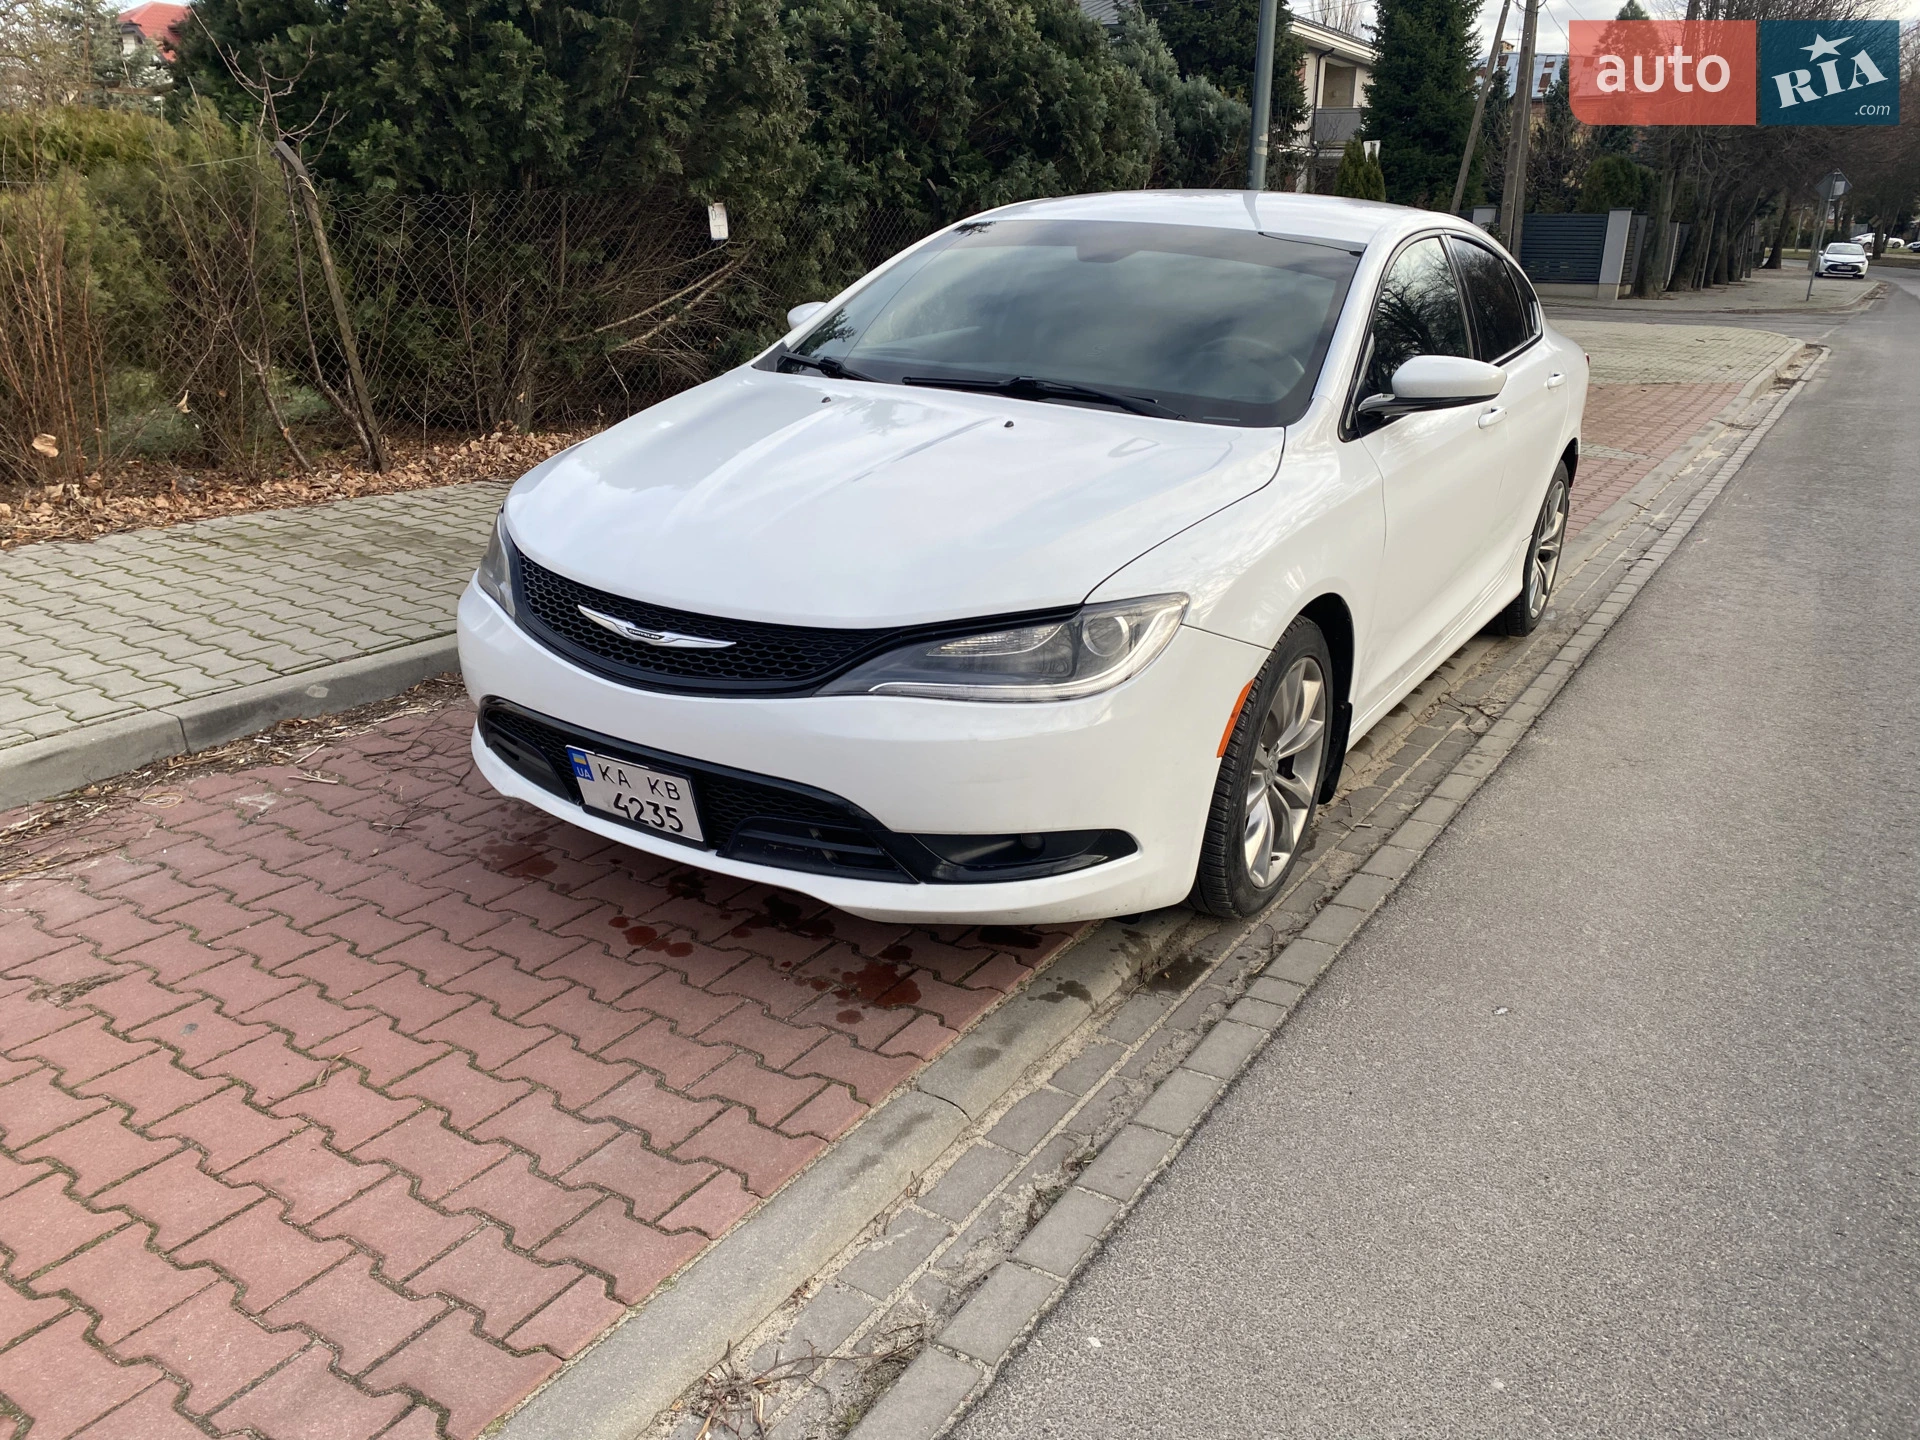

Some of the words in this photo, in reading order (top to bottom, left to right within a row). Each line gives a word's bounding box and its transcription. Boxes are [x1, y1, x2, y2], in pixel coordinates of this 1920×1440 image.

[576, 766, 592, 780] UA
[597, 763, 632, 789] KA
[646, 776, 681, 801] KB
[613, 792, 684, 833] 4235
